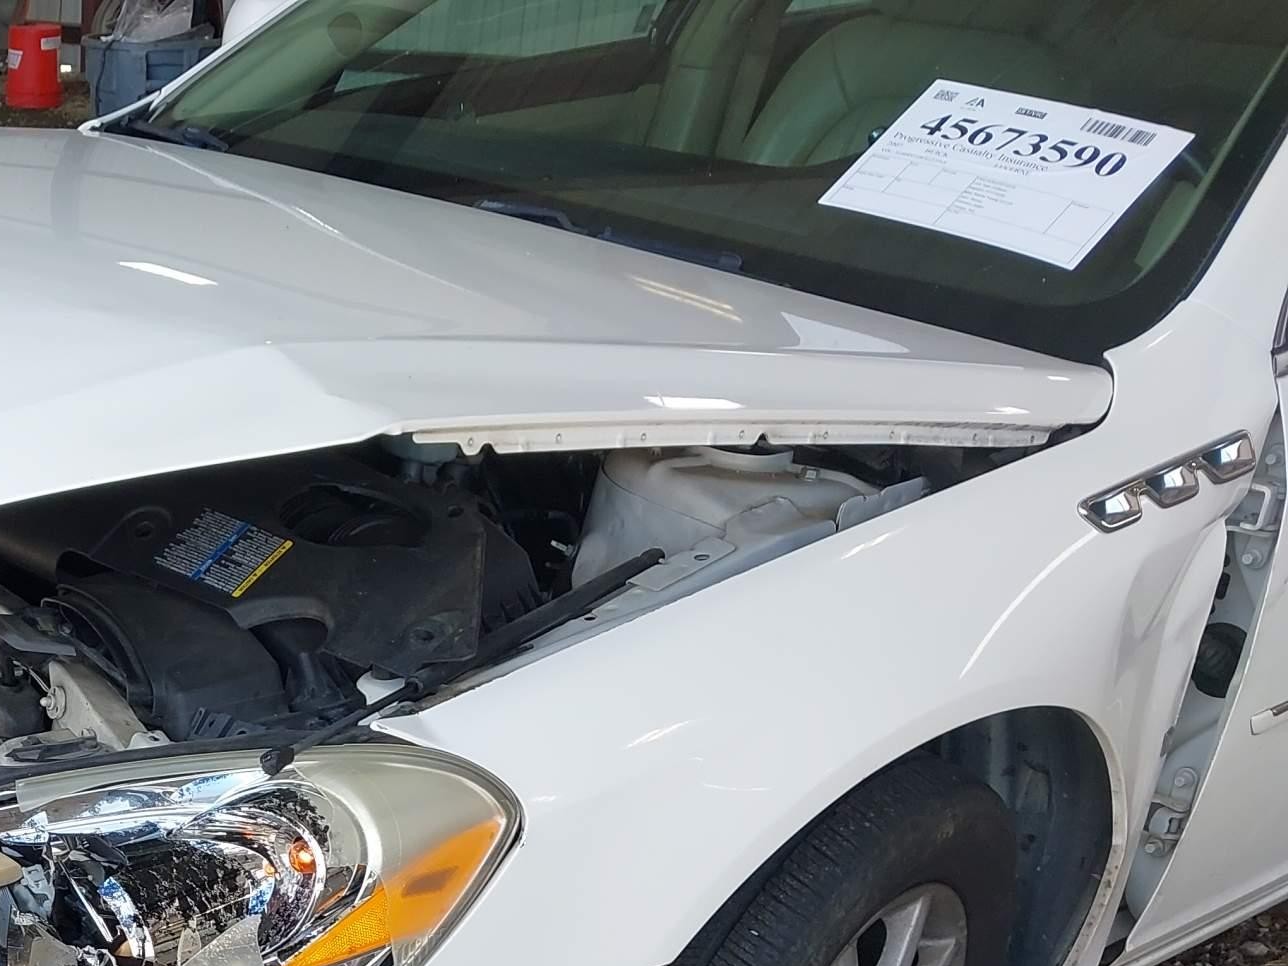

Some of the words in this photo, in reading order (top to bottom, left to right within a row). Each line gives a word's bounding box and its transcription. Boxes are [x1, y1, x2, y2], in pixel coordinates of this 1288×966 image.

[893, 131, 951, 150] Progressive
[952, 144, 993, 160] Casualty
[997, 153, 1048, 172] Insurance
[920, 113, 1128, 177] 45673590
